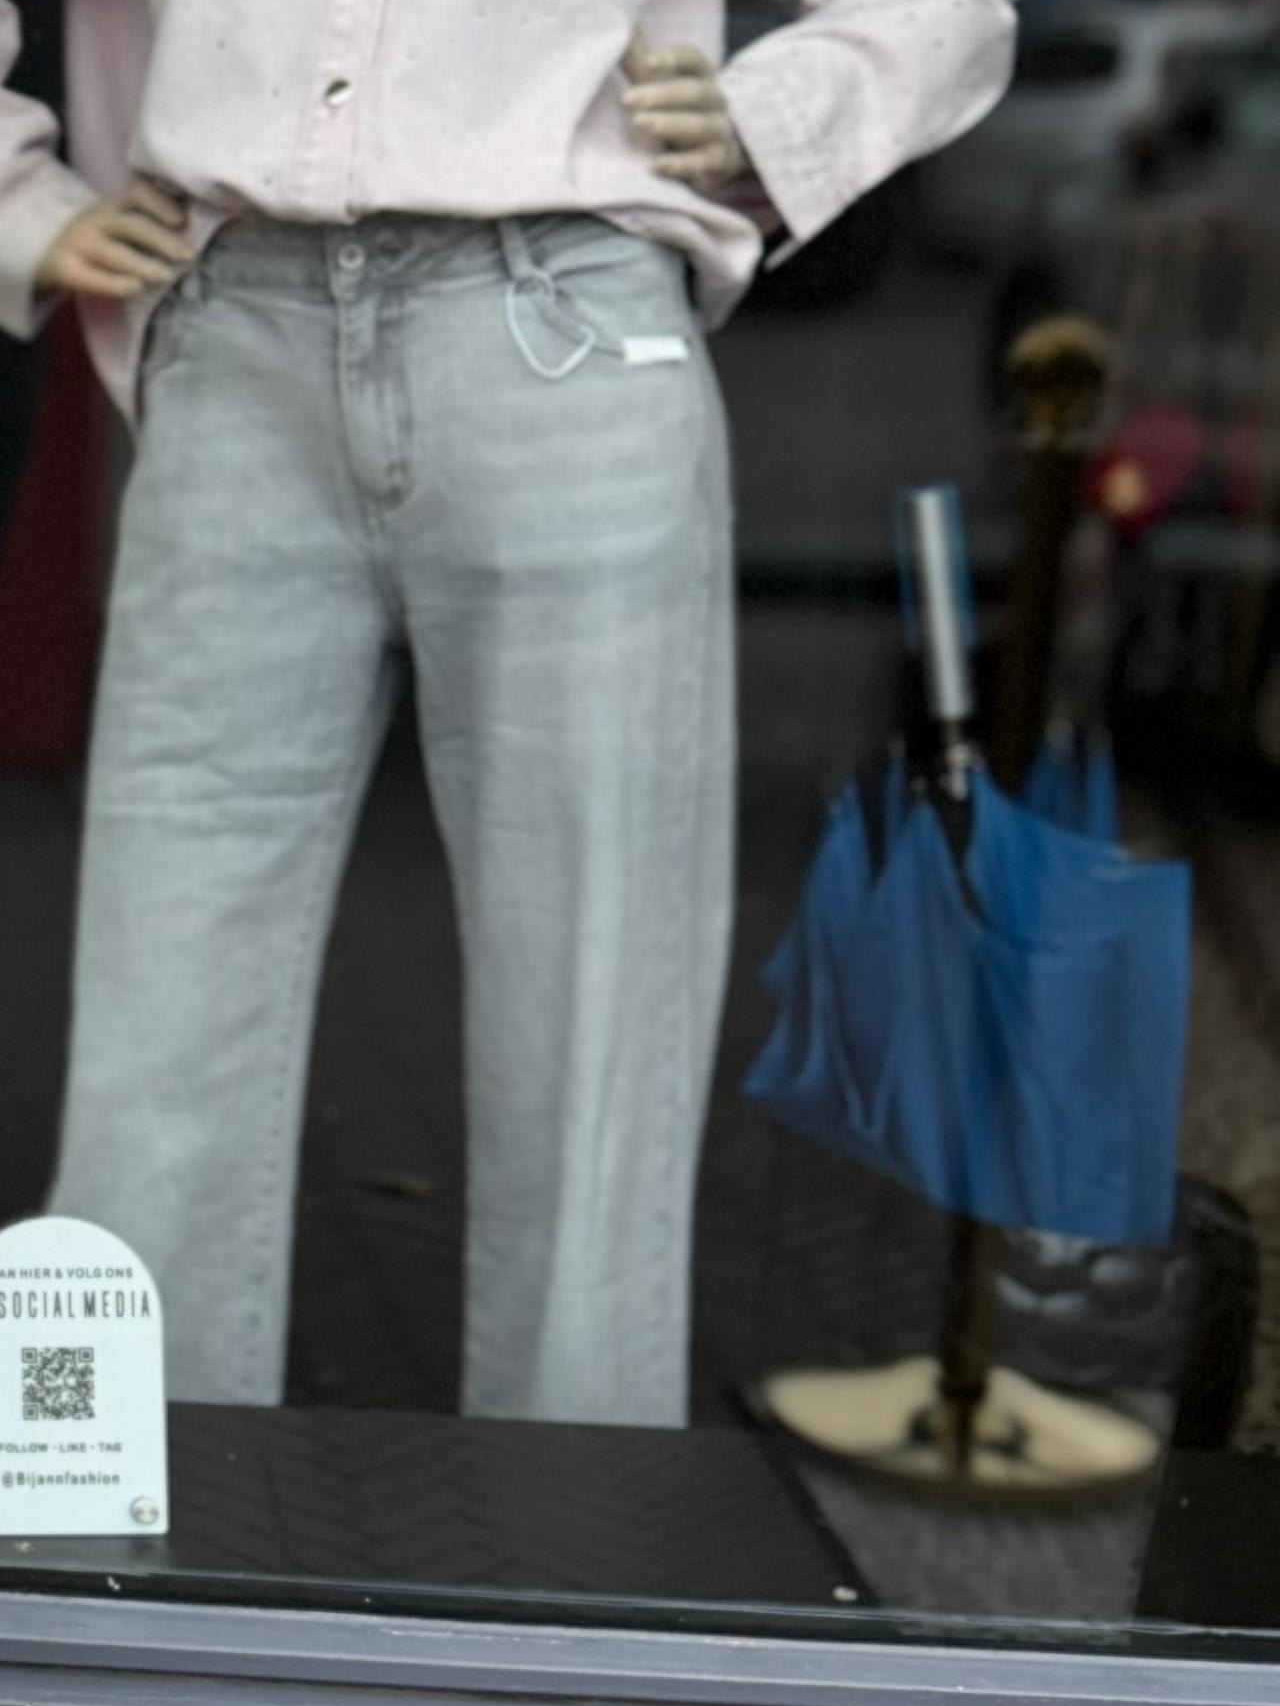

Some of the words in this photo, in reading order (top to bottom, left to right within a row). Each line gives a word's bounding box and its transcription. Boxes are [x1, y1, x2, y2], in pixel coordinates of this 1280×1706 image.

[19, 1268, 51, 1279] HIER
[54, 1267, 63, 1279] &
[66, 1267, 102, 1279] VOLG
[105, 1267, 133, 1279] ONS
[83, 1290, 150, 1319] MEDIA
[59, 1442, 87, 1453] LIKE
[98, 1442, 122, 1453] TAG
[1, 1471, 120, 1489] @Bijannfashion
